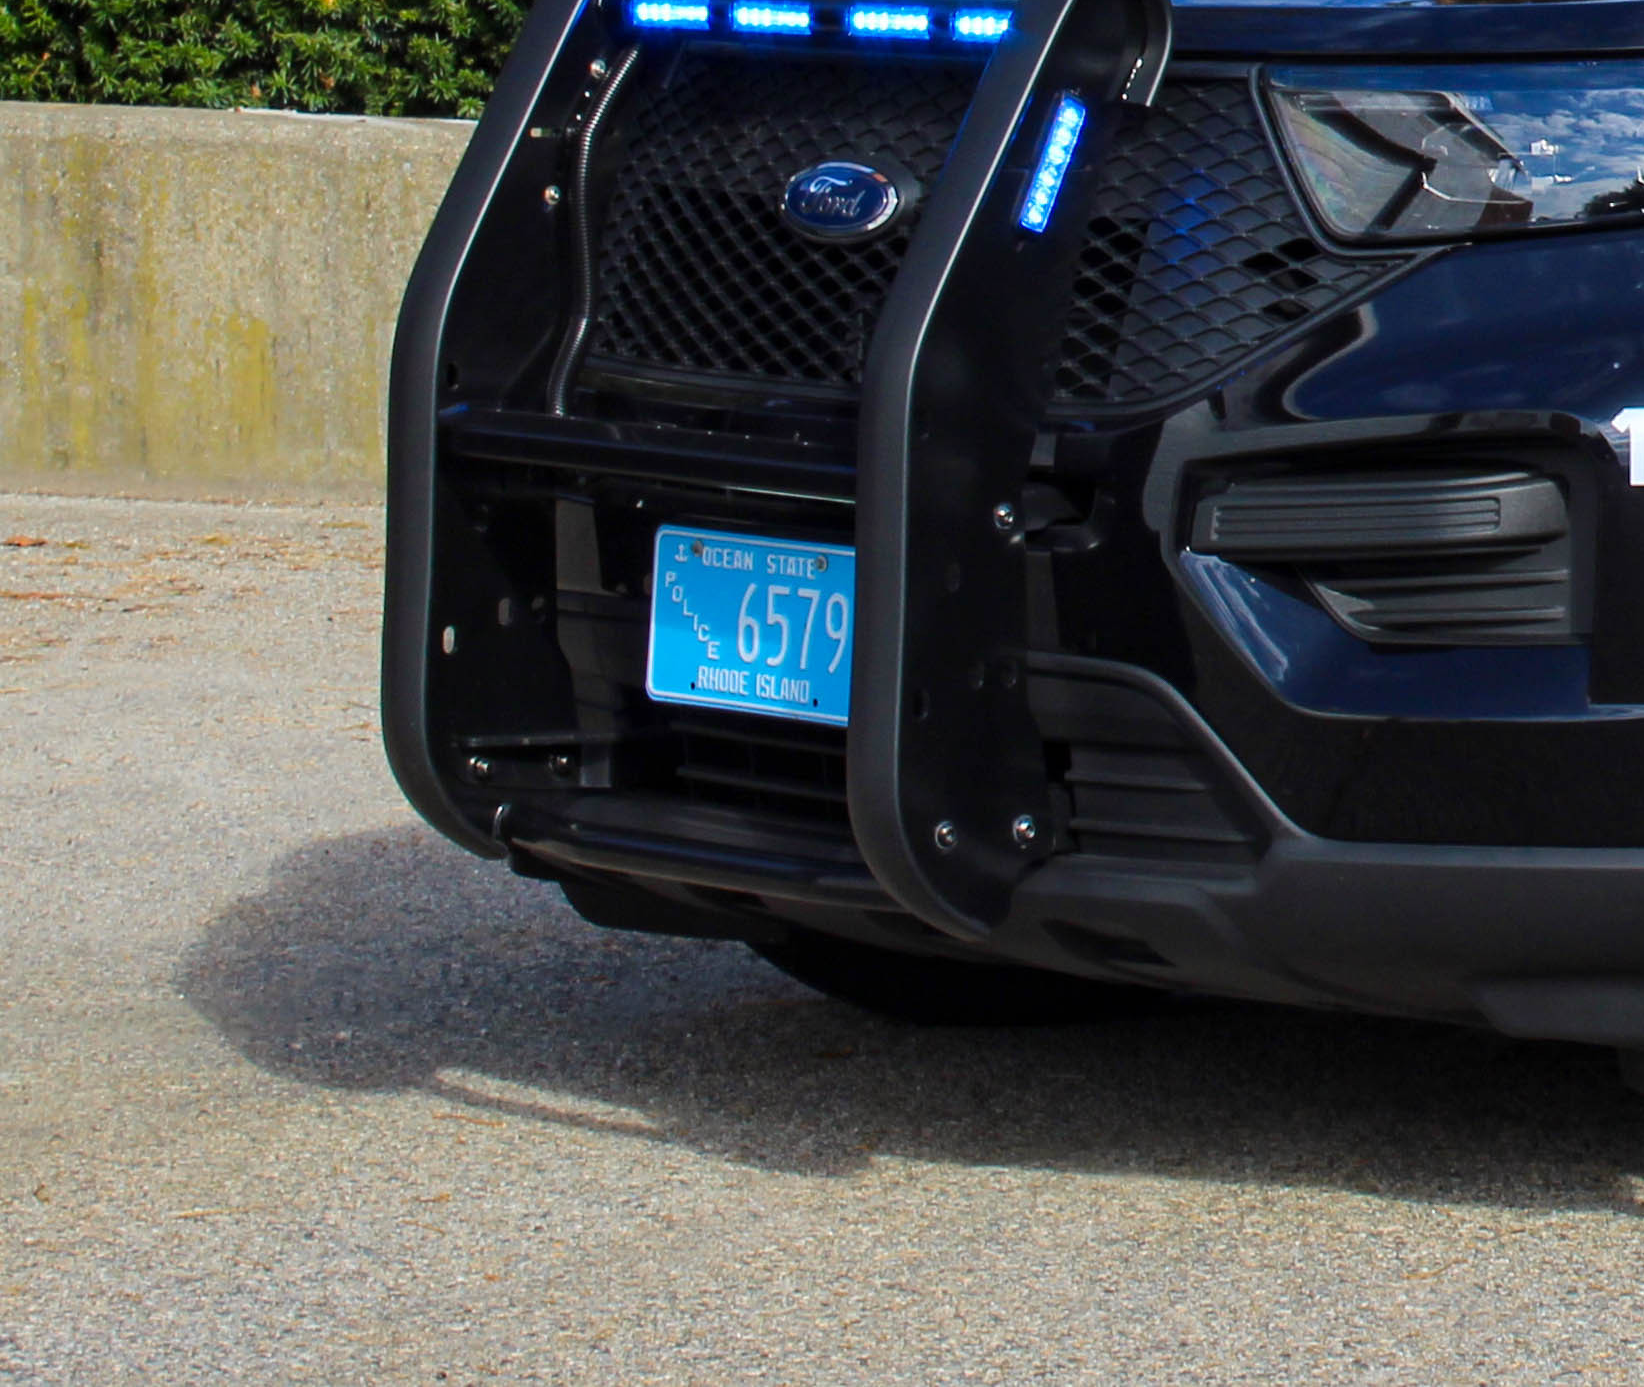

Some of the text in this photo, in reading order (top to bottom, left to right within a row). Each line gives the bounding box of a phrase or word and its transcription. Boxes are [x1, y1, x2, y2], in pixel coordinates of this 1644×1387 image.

[800, 175, 867, 217] Ford
[702, 545, 816, 580] OCEAN STATE
[664, 570, 721, 660] POLICE
[736, 582, 849, 674] 6579
[696, 665, 810, 704] RHODE ISLAND
